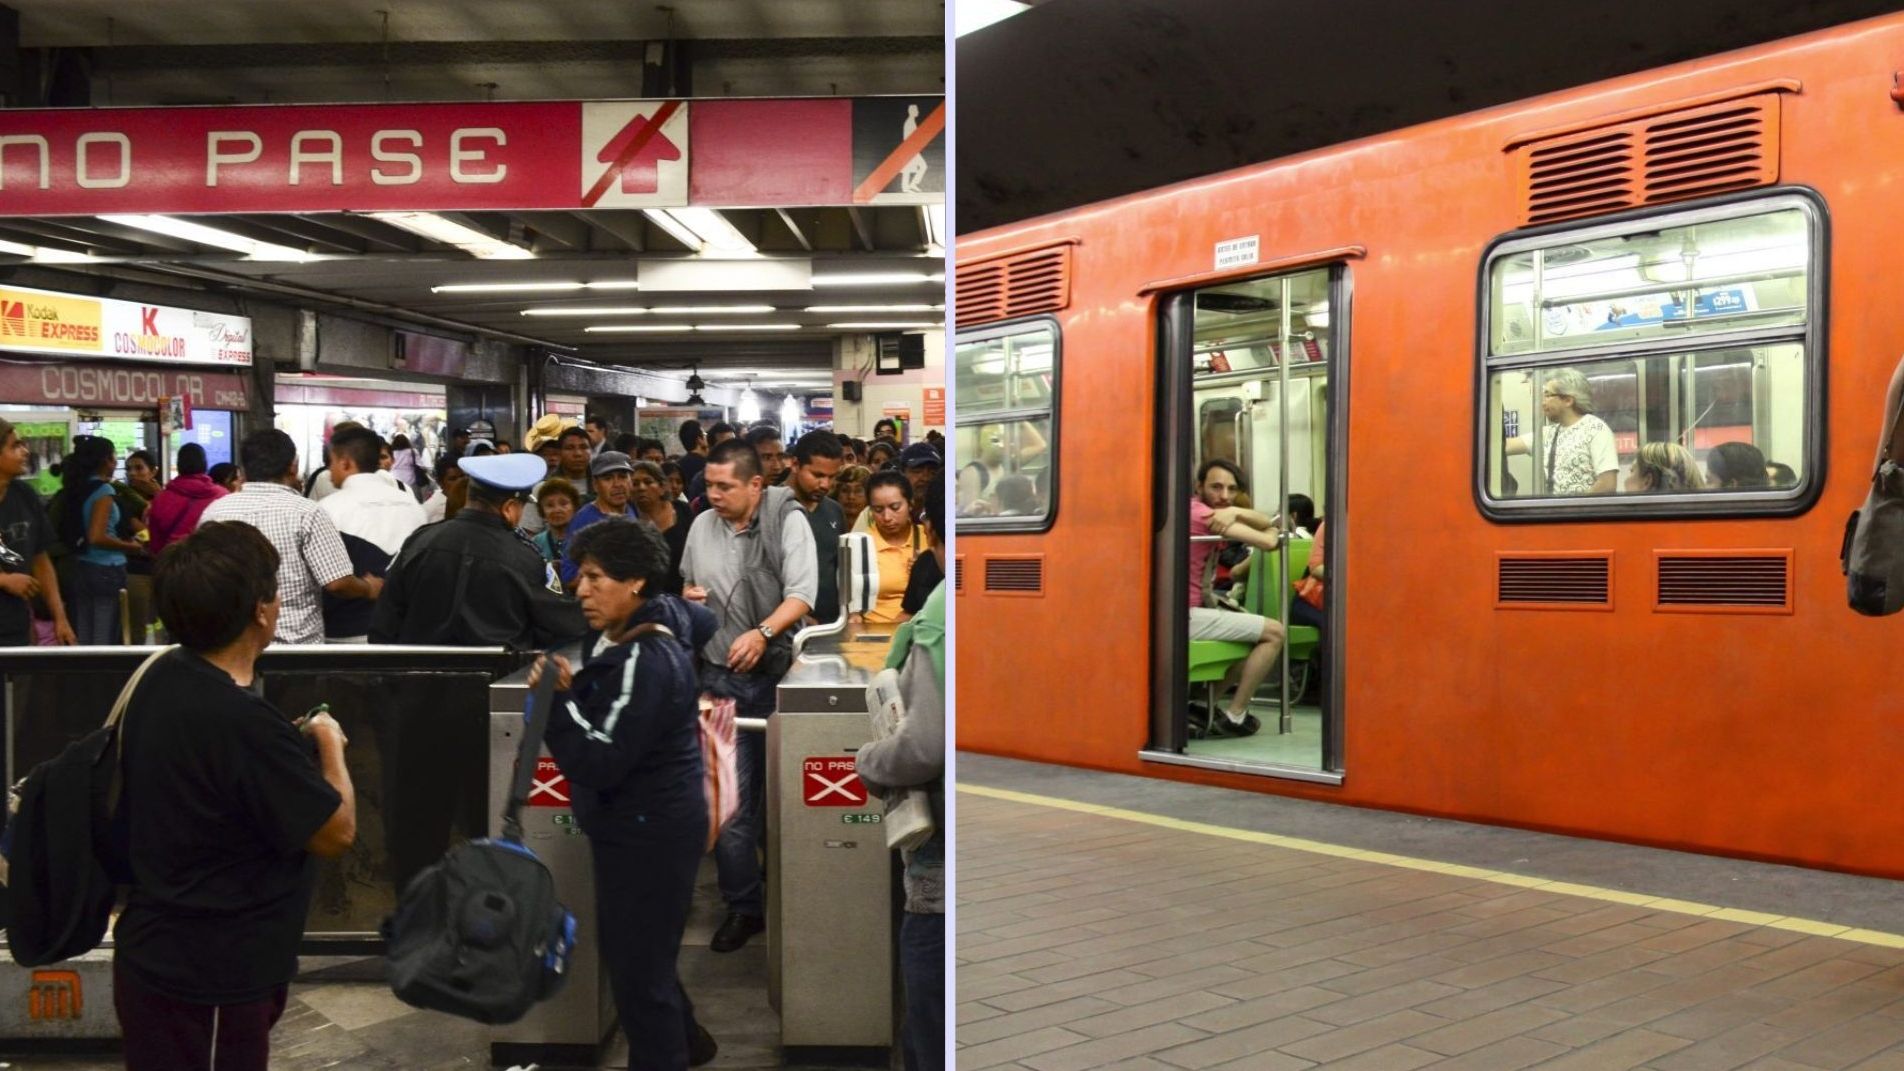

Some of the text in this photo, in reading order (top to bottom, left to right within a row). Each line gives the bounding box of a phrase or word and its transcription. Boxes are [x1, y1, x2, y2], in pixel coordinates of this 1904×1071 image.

[206, 127, 507, 187] PASE
[27, 303, 59, 320] Kodak
[141, 306, 159, 336] K
[41, 321, 99, 341] EXPRESS
[208, 321, 250, 348] Digital
[114, 332, 187, 358] COSMOCOLOR
[217, 349, 251, 362] EXPRESS
[828, 761, 855, 771] PAS
[858, 814, 880, 823] 149
